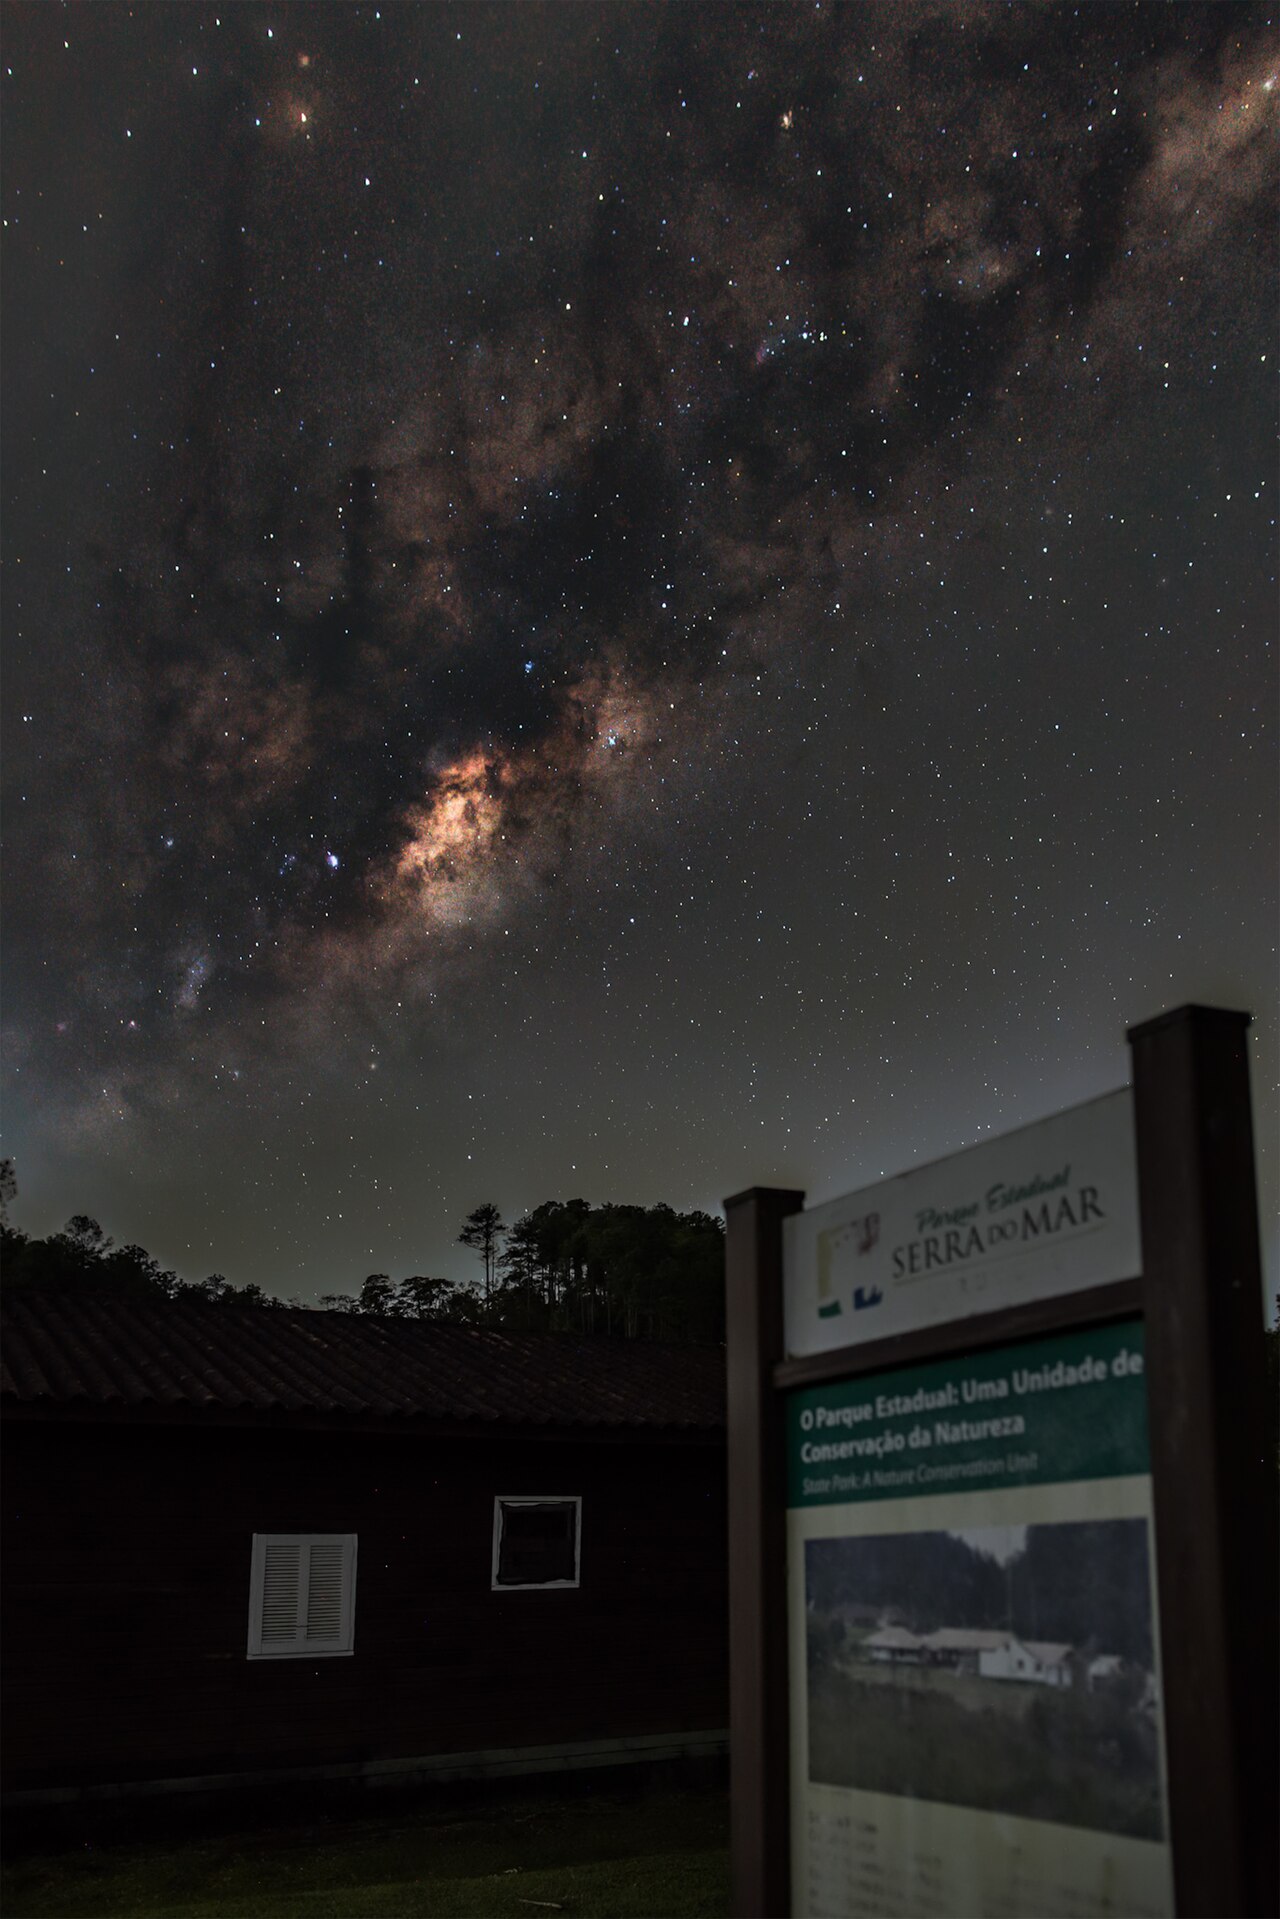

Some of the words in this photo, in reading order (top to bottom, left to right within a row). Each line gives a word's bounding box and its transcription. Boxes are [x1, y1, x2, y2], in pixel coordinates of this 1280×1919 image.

[892, 1226, 985, 1280] SERRA
[988, 1219, 1018, 1246] DO
[1020, 1186, 1104, 1240] MAR
[915, 1203, 980, 1233] Parque
[986, 1164, 1072, 1214] Estadual
[799, 1409, 814, 1431] O
[816, 1403, 872, 1428] Parque
[876, 1382, 960, 1418] Estadual:
[962, 1377, 1009, 1404] Uma
[1012, 1355, 1108, 1395] Unidade
[1111, 1348, 1144, 1378] de
[801, 1431, 904, 1464] Conservação
[908, 1424, 932, 1448] da
[935, 1415, 1026, 1446] Natureza
[802, 1477, 831, 1497] State
[863, 1468, 872, 1487] A
[873, 1465, 915, 1487] Nature
[916, 1454, 1006, 1482] Conservation
[1007, 1452, 1038, 1473] Unit
